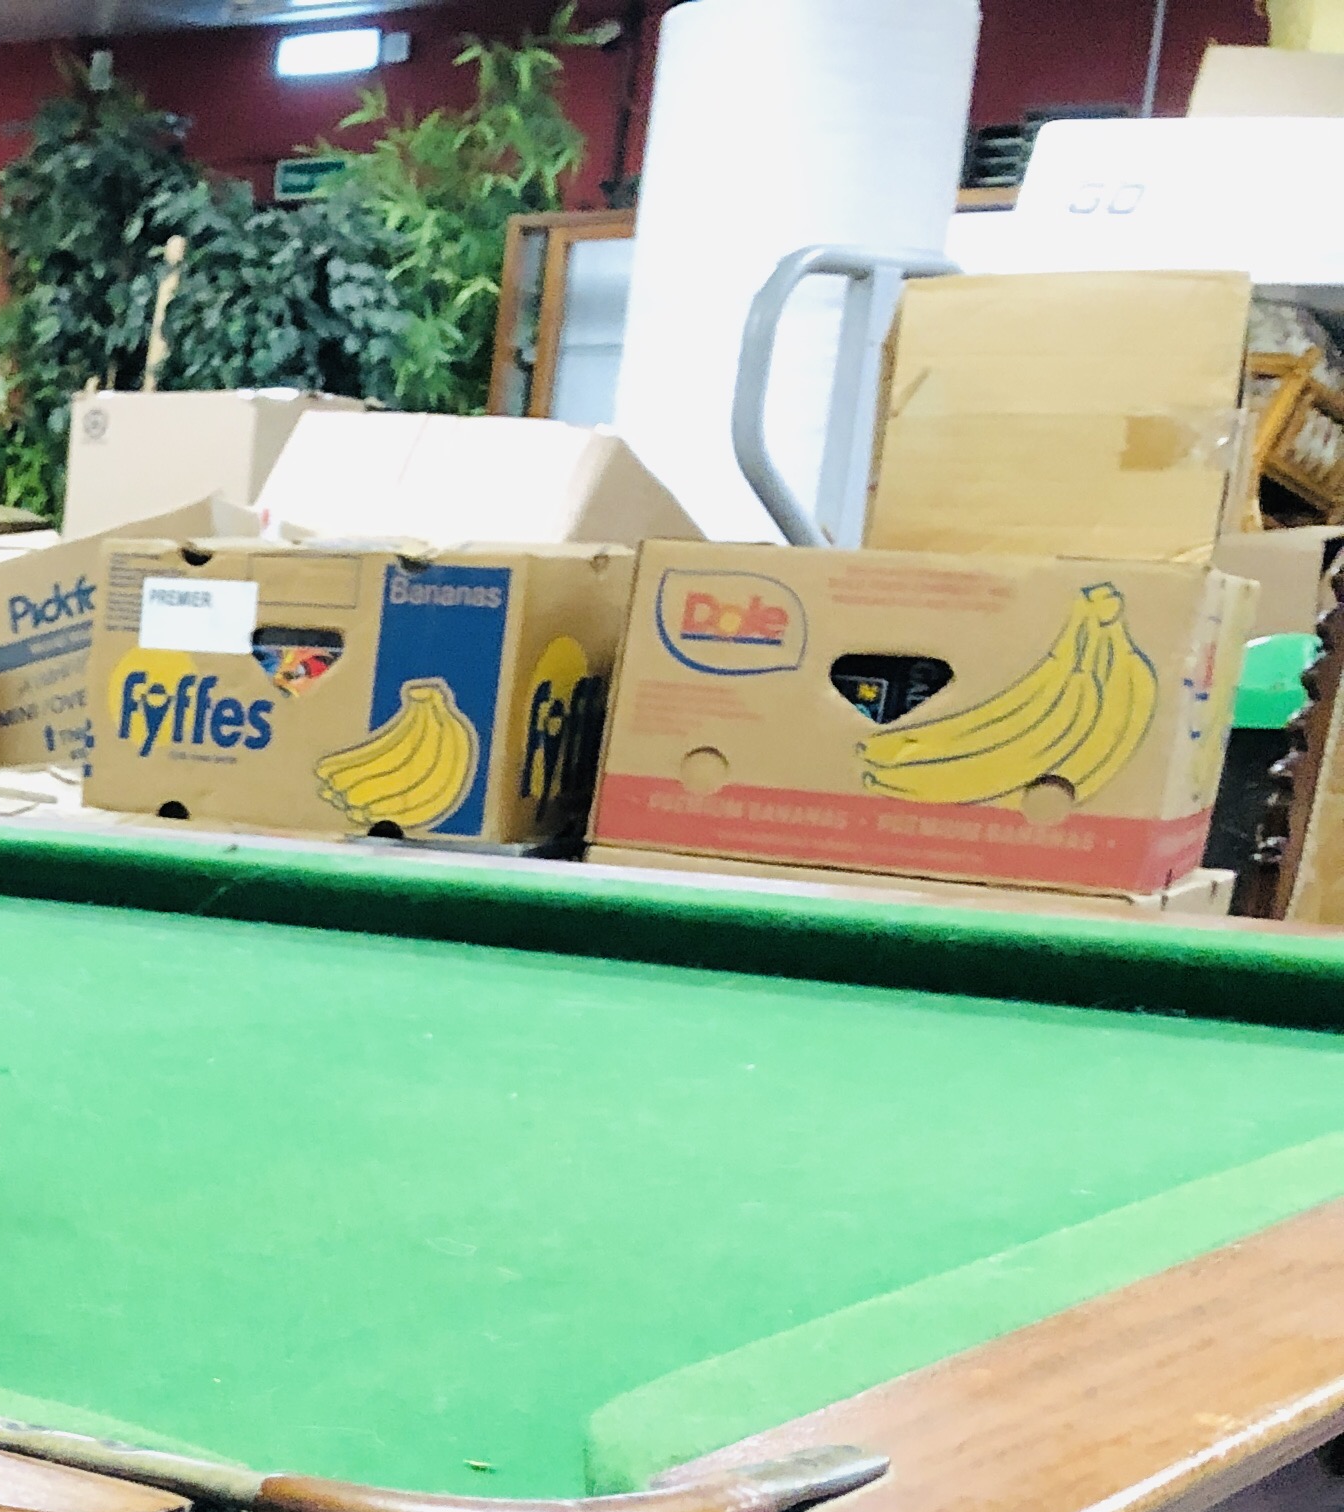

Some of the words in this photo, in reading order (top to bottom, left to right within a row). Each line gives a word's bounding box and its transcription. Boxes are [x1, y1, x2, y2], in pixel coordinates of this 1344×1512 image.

[390, 576, 502, 608] Bananas
[682, 591, 789, 638] Dole
[119, 671, 274, 757] fyffes
[748, 800, 848, 830] BANANAS
